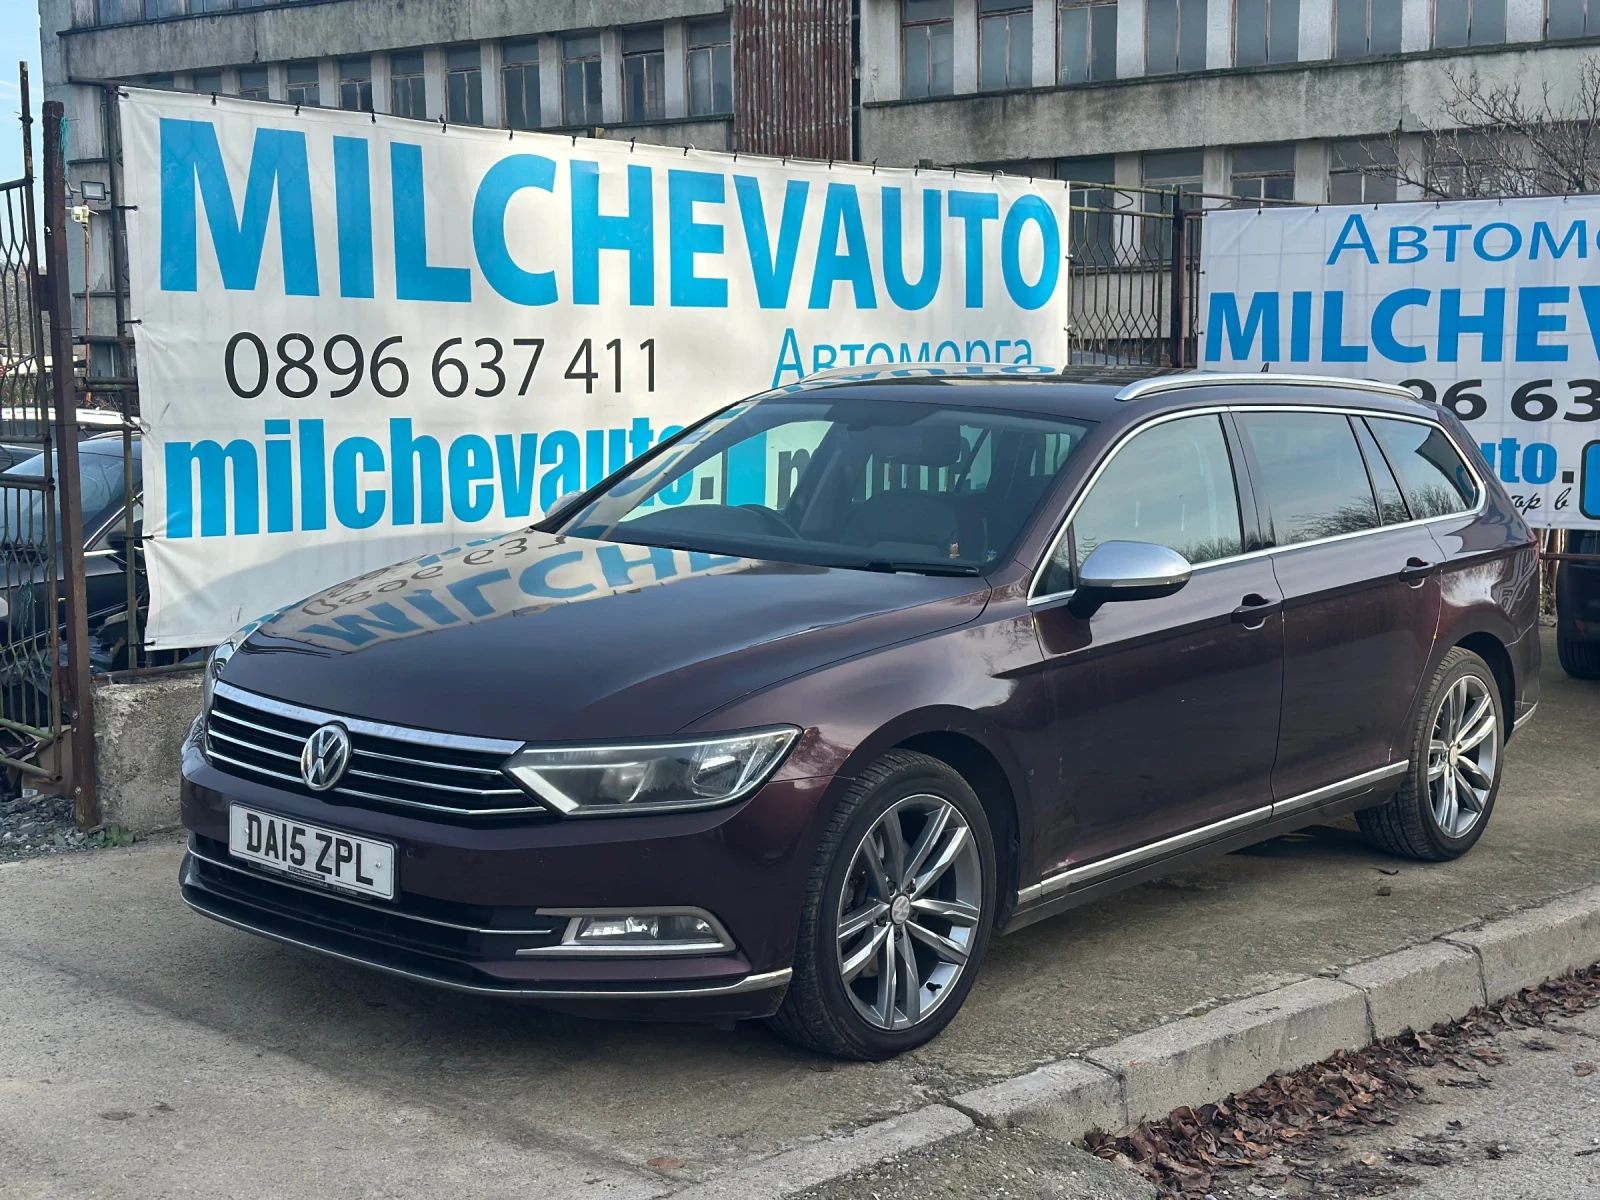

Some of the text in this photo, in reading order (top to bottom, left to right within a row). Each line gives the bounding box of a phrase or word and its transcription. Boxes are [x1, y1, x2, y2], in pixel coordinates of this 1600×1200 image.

[160, 117, 1061, 311] MILCHEVAUTO
[1326, 213, 1600, 266] Автом
[224, 331, 656, 399] 0896 637 411
[246, 812, 374, 887] DA15 ZPL
